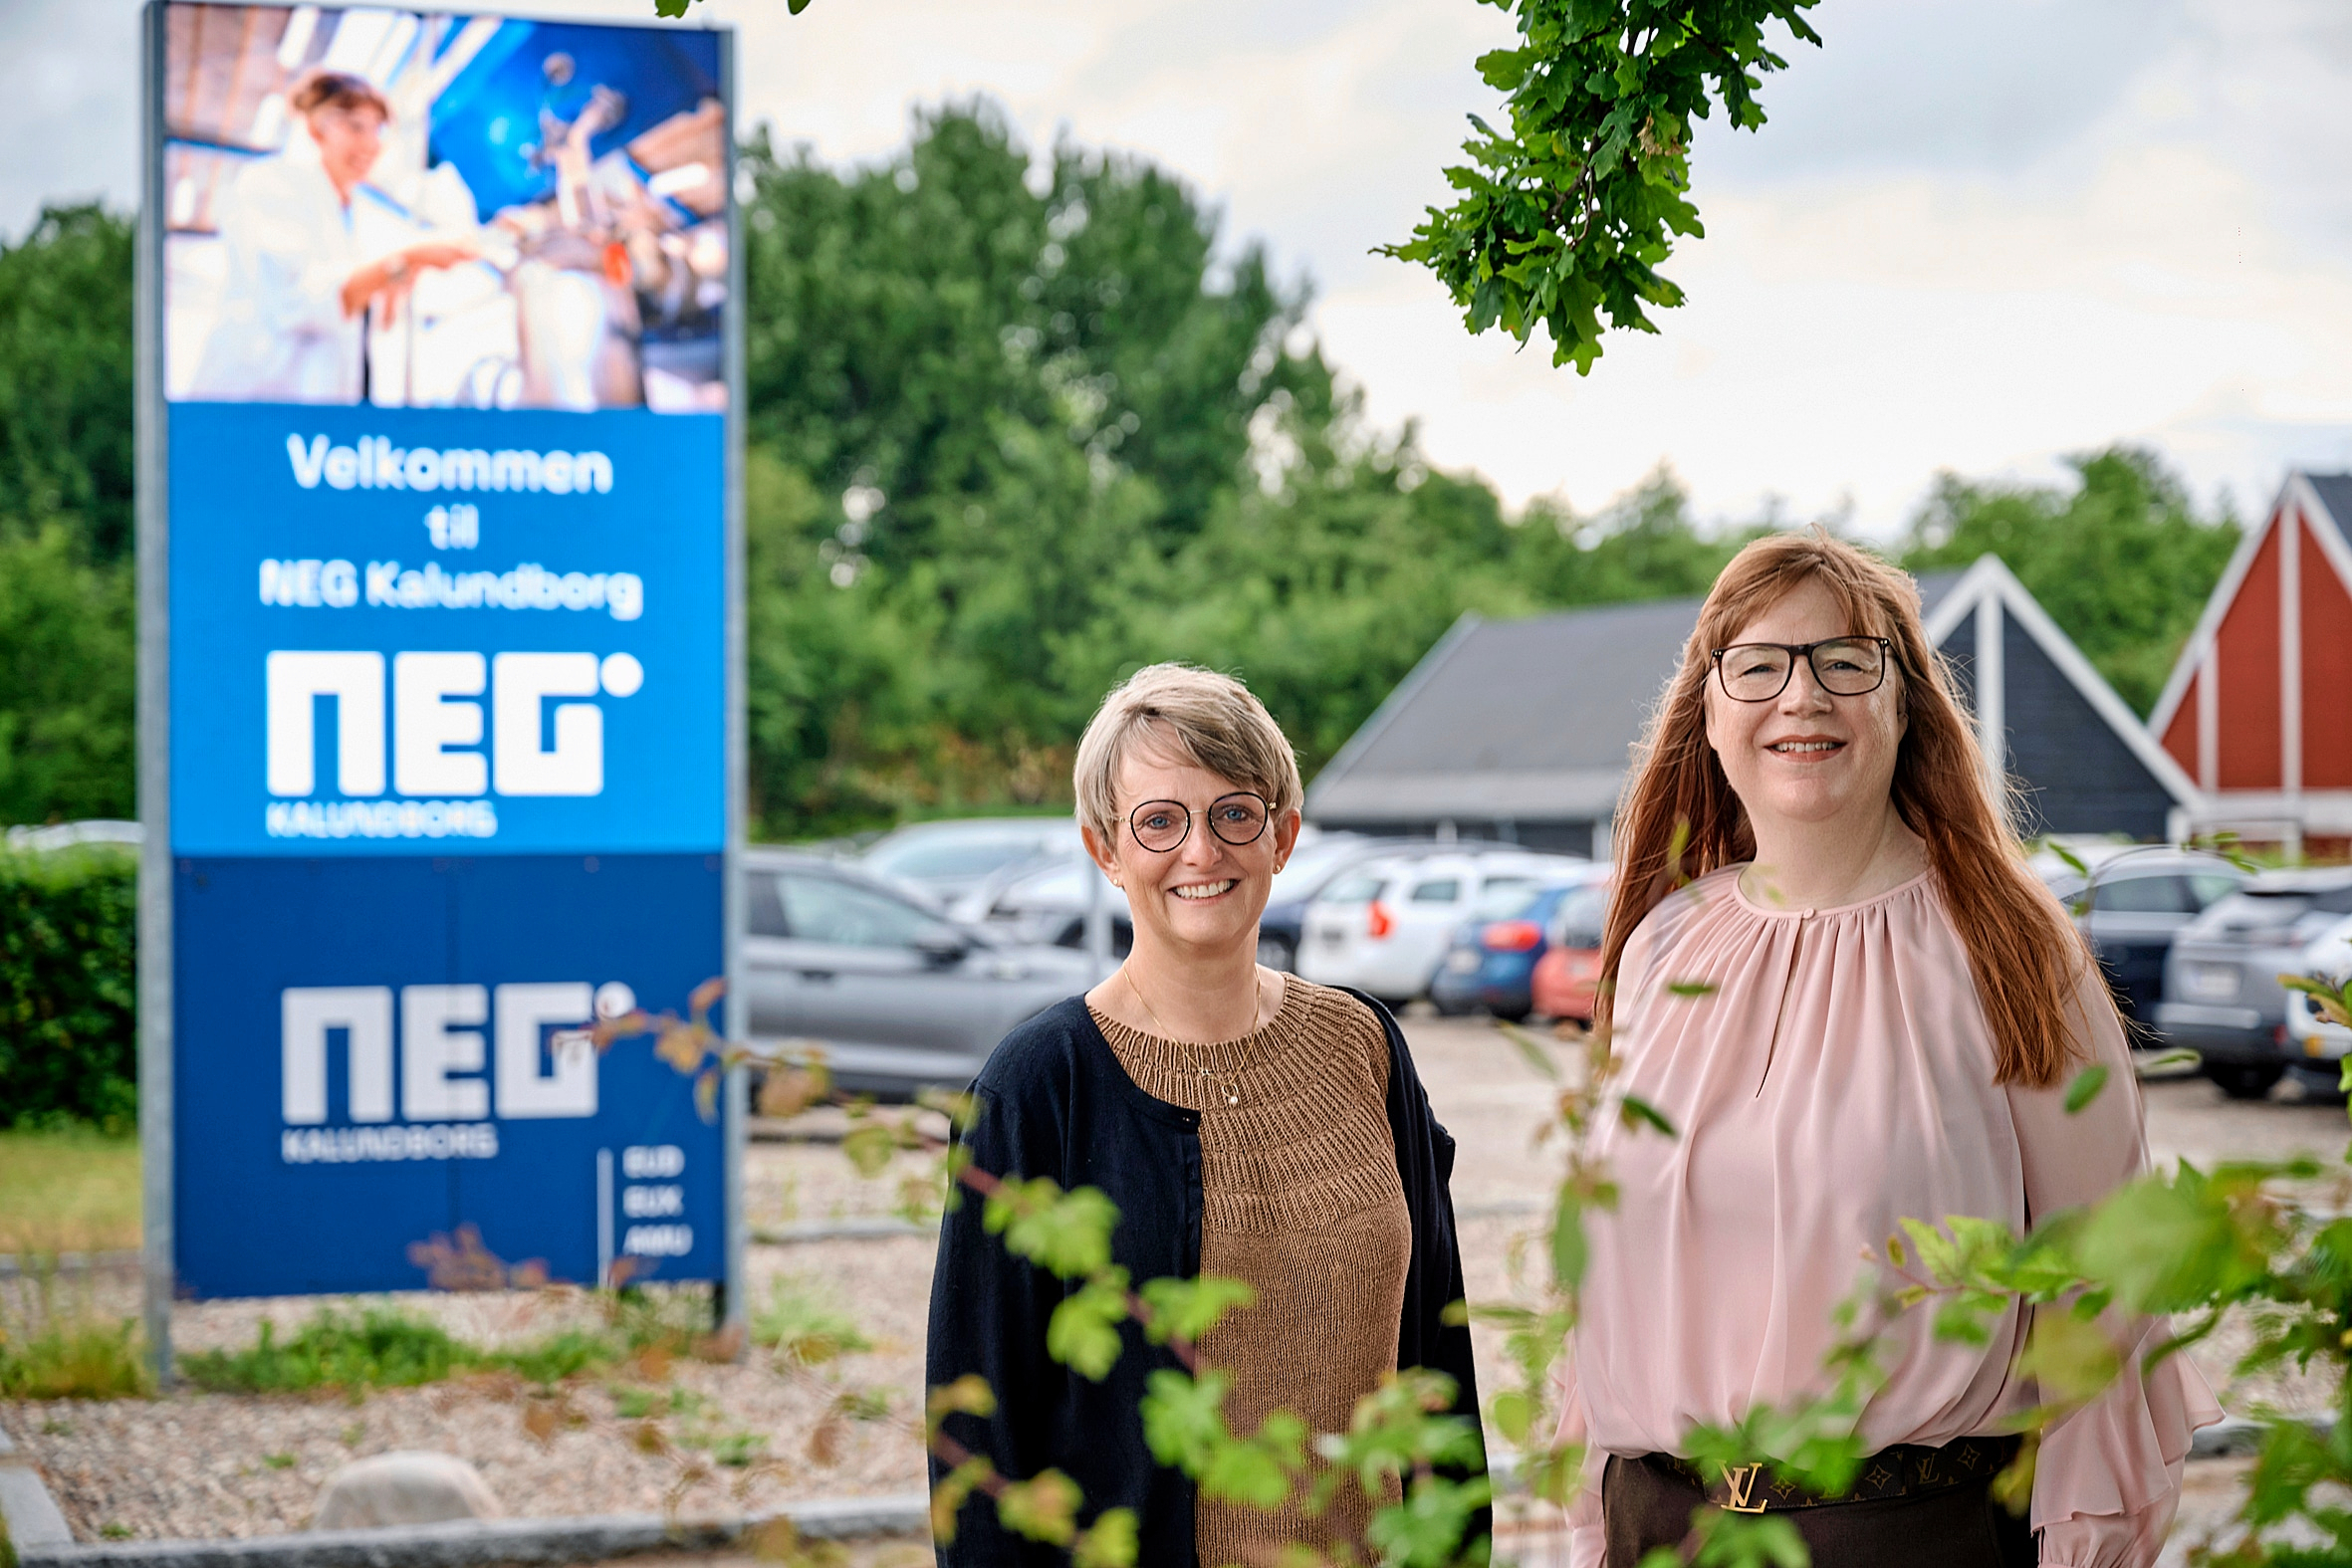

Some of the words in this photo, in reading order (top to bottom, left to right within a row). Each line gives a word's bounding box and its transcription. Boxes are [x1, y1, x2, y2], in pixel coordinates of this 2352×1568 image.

[286, 433, 613, 494] Velkommen
[424, 504, 480, 550] til
[259, 559, 358, 608] NEG
[365, 560, 644, 621] Kalundborg
[265, 649, 603, 797] NEG
[265, 799, 498, 838] KALUNDBORG
[281, 983, 597, 1123] NEG
[281, 1123, 499, 1164] KALUNDBORG
